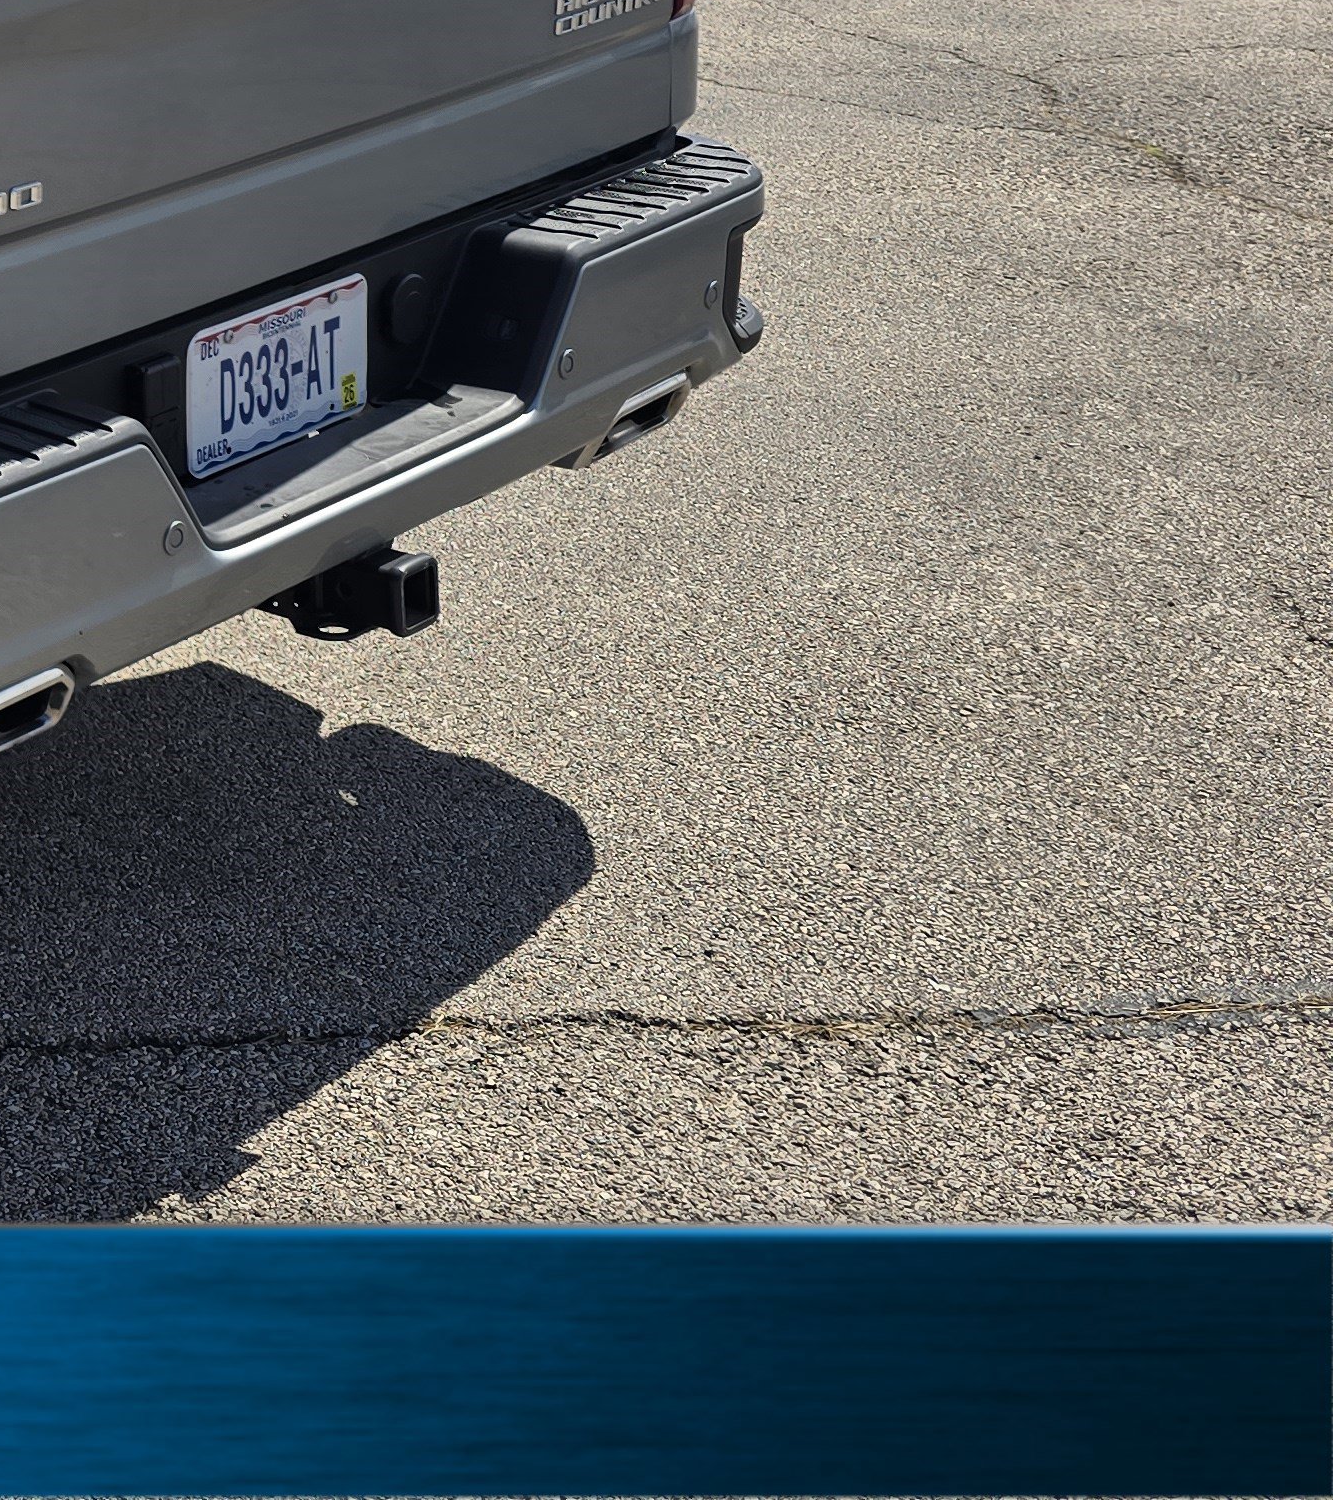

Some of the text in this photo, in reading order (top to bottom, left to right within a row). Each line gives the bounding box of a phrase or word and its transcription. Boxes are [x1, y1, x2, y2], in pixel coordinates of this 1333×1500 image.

[258, 307, 307, 335] MISSOURI
[200, 338, 220, 361] DEC
[220, 315, 341, 435] D333-AT
[343, 383, 355, 404] 26
[197, 438, 228, 465] DEALER
